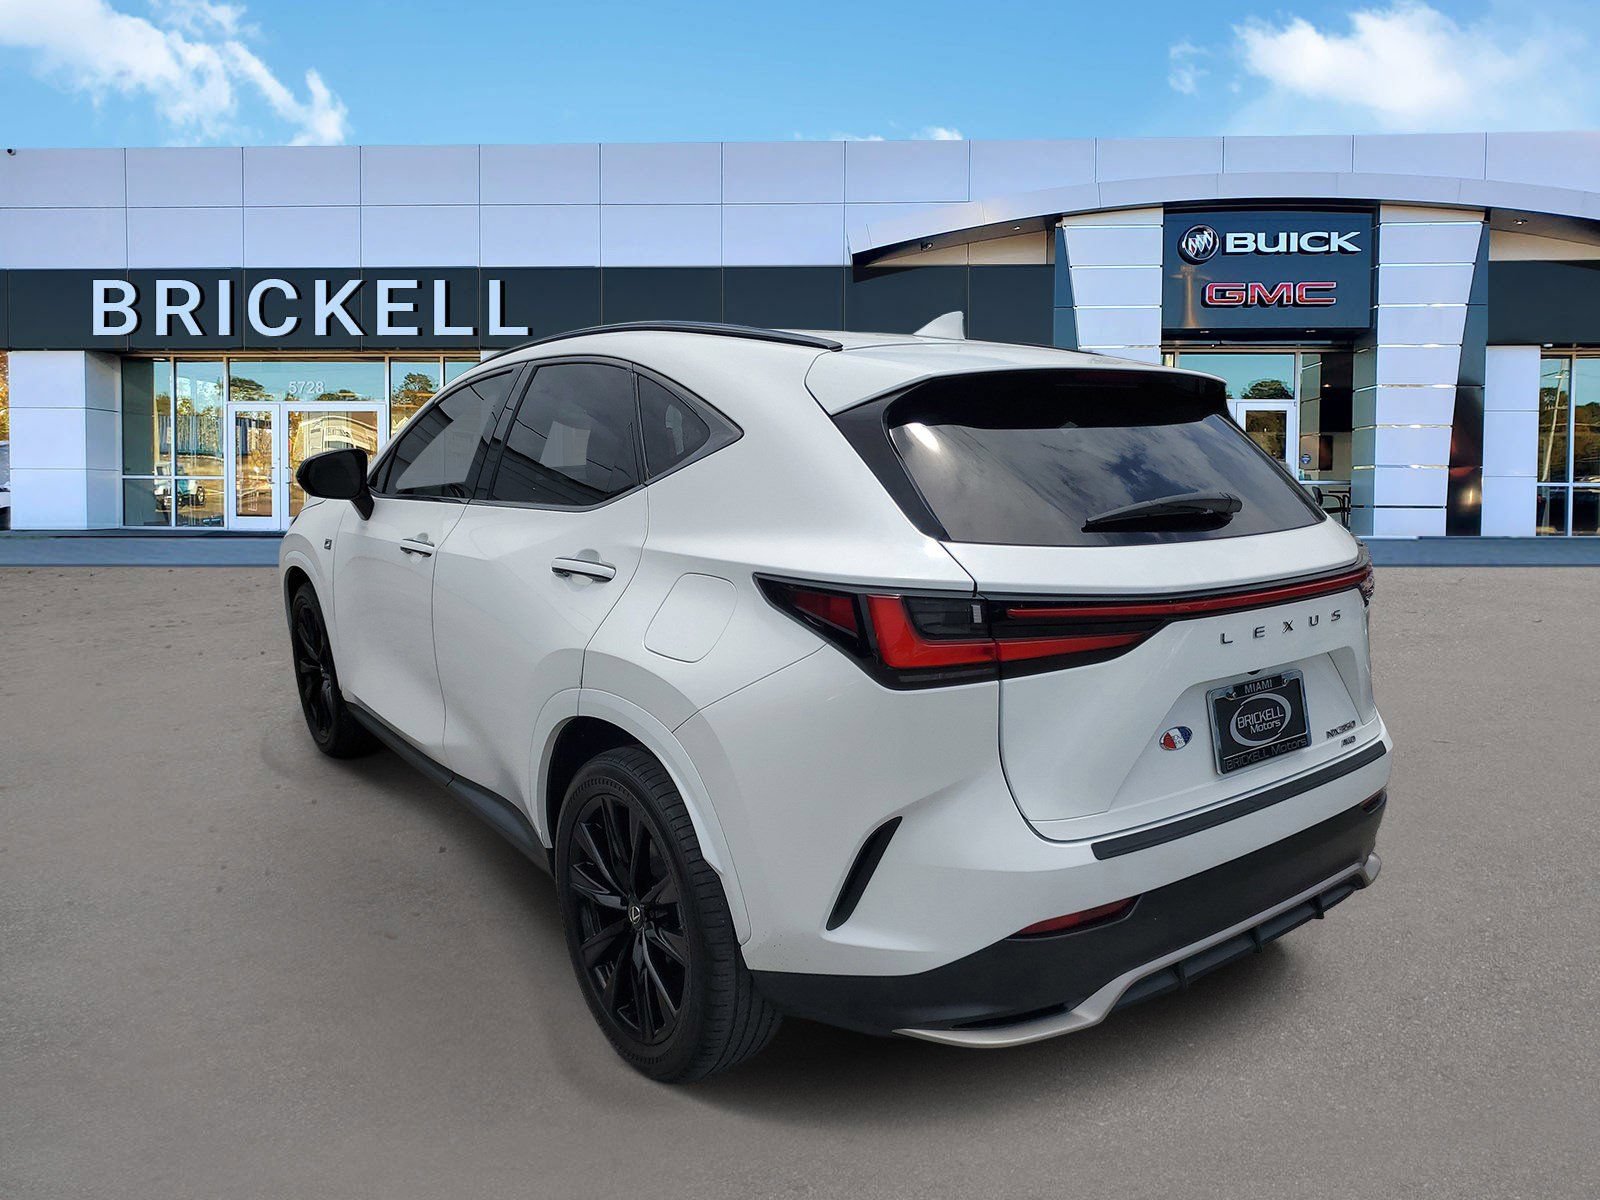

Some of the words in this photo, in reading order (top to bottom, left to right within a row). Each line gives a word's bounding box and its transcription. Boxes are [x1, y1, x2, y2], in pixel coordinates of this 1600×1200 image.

[1226, 231, 1361, 254] BUICK
[1204, 281, 1338, 306] GMC
[92, 278, 530, 337] BRICKELL
[289, 381, 325, 395] 5728
[1220, 609, 1342, 645] LEXUS
[1244, 679, 1273, 694] MIAMI
[1237, 706, 1284, 729] BRICKELL
[1250, 720, 1282, 735] Motors
[1226, 749, 1269, 771] BRICKELL
[1271, 738, 1308, 755] Motors
